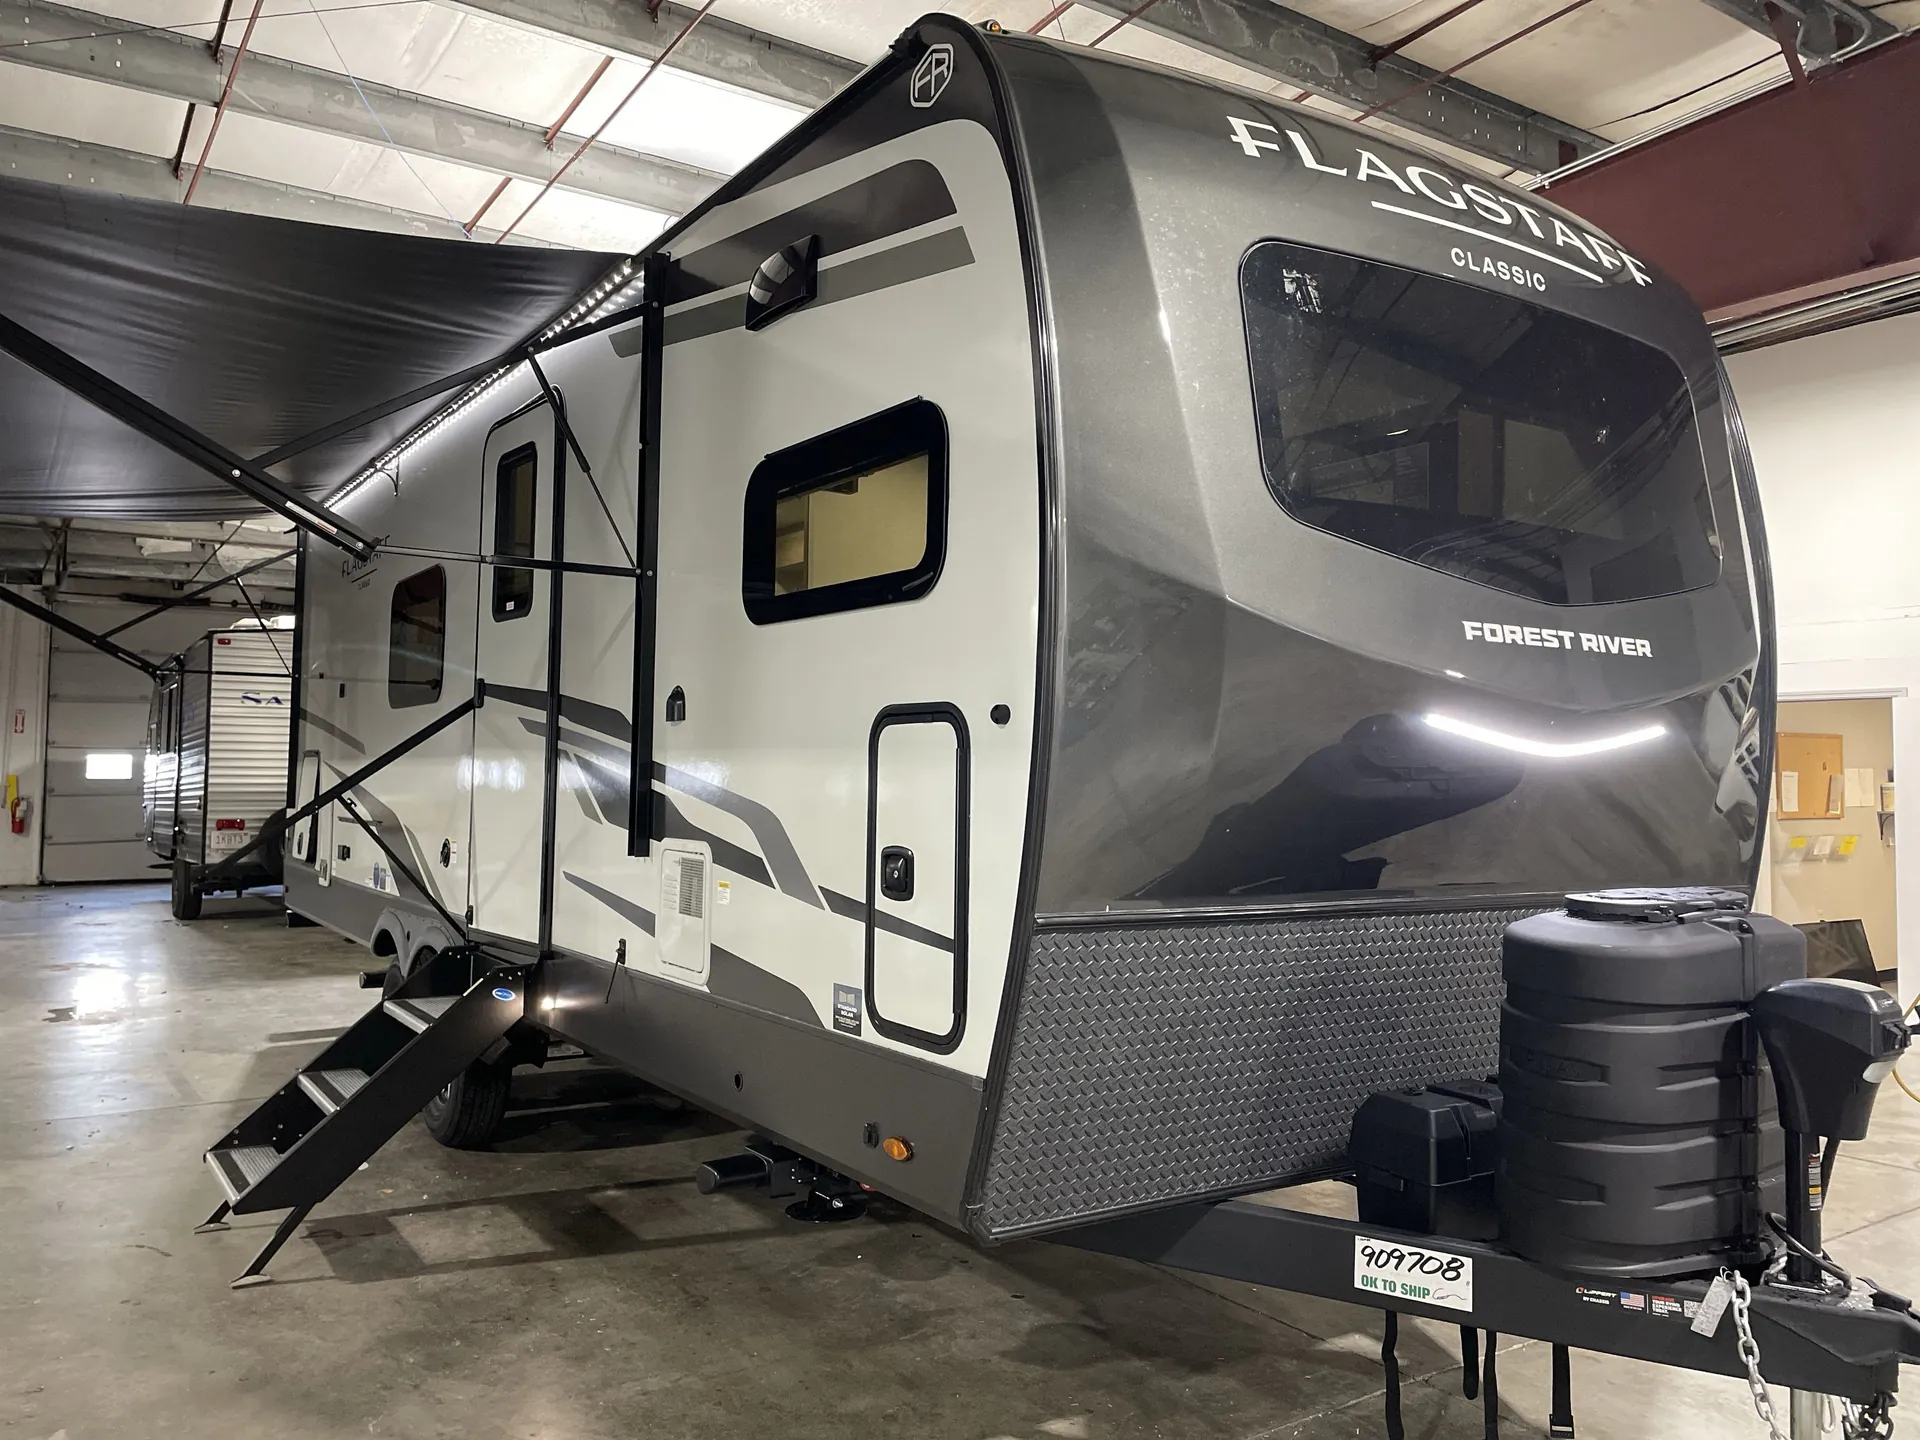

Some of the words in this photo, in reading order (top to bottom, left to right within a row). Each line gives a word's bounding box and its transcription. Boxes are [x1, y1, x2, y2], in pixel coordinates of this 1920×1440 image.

[1226, 115, 1653, 287] FLAGSTAFF
[1450, 247, 1547, 292] CLASSIC
[1461, 620, 1575, 650] FOREST
[1578, 632, 1654, 658] RIVER
[1360, 1244, 1466, 1282] 909708
[1361, 1274, 1379, 1290] OK
[1381, 1278, 1397, 1293] TO
[1400, 1282, 1431, 1299] SHIP
